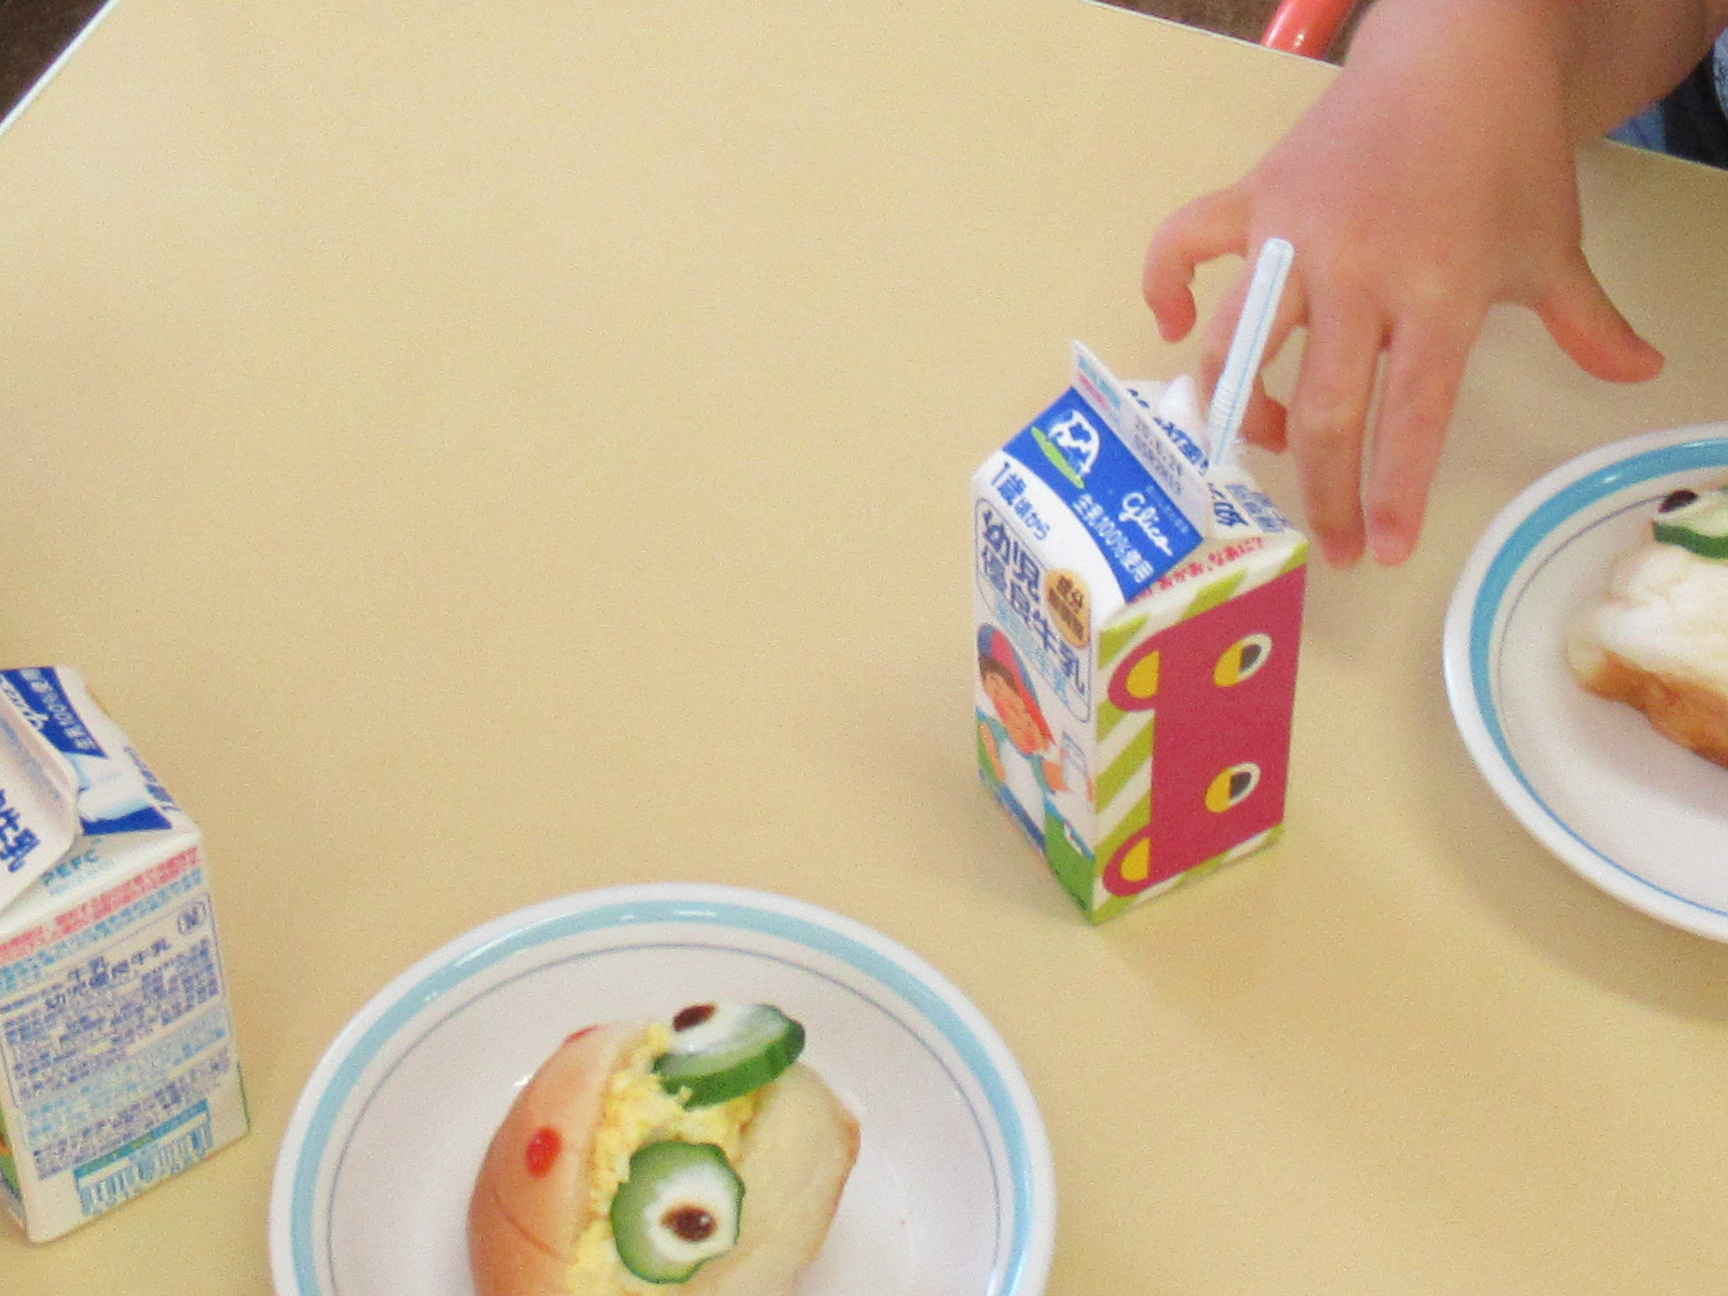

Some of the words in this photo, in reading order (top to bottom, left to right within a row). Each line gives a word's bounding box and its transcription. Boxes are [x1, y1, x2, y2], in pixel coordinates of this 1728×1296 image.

[1072, 493, 1156, 584] 生乳100%使用
[1118, 491, 1174, 557] Glico
